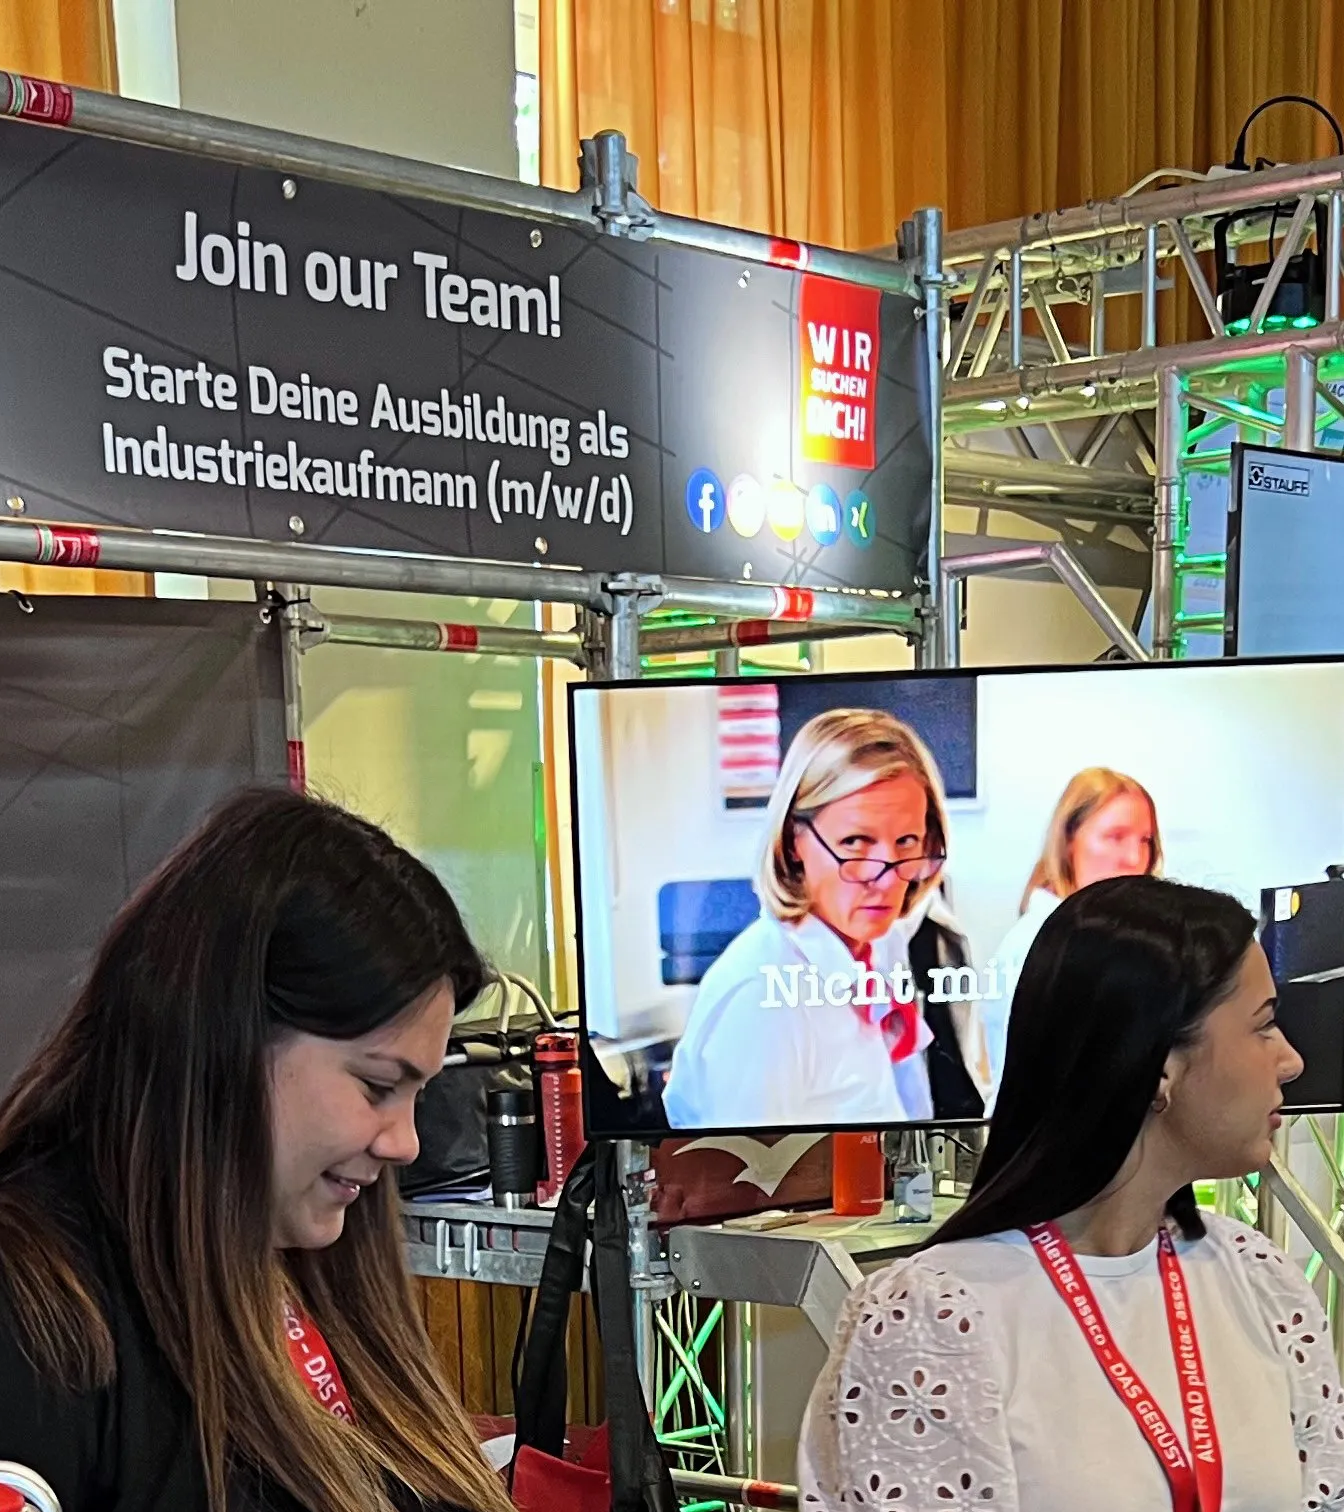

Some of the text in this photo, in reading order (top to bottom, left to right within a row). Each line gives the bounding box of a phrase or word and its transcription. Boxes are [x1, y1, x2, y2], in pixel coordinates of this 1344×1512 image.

[175, 210, 563, 338] Join our Team!
[807, 321, 873, 372] WIR
[102, 346, 630, 465] Starte Deine Ausbildung als
[810, 368, 867, 398] SUCHEN
[807, 396, 866, 441] DICH!
[102, 423, 636, 537] Industriekaufmann (m/w/d)
[1263, 476, 1309, 494] STAUFF
[759, 961, 915, 1010] Nicht
[1168, 1271, 1188, 1321] assco
[1031, 1230, 1080, 1293] plettac
[1072, 1295, 1107, 1346] assco
[1109, 1362, 1143, 1400] DAS
[1135, 1399, 1186, 1470] GERÜST
[1180, 1324, 1206, 1387] plettac
[304, 1356, 337, 1401] DAS
[1186, 1391, 1216, 1463] ALTRAD
